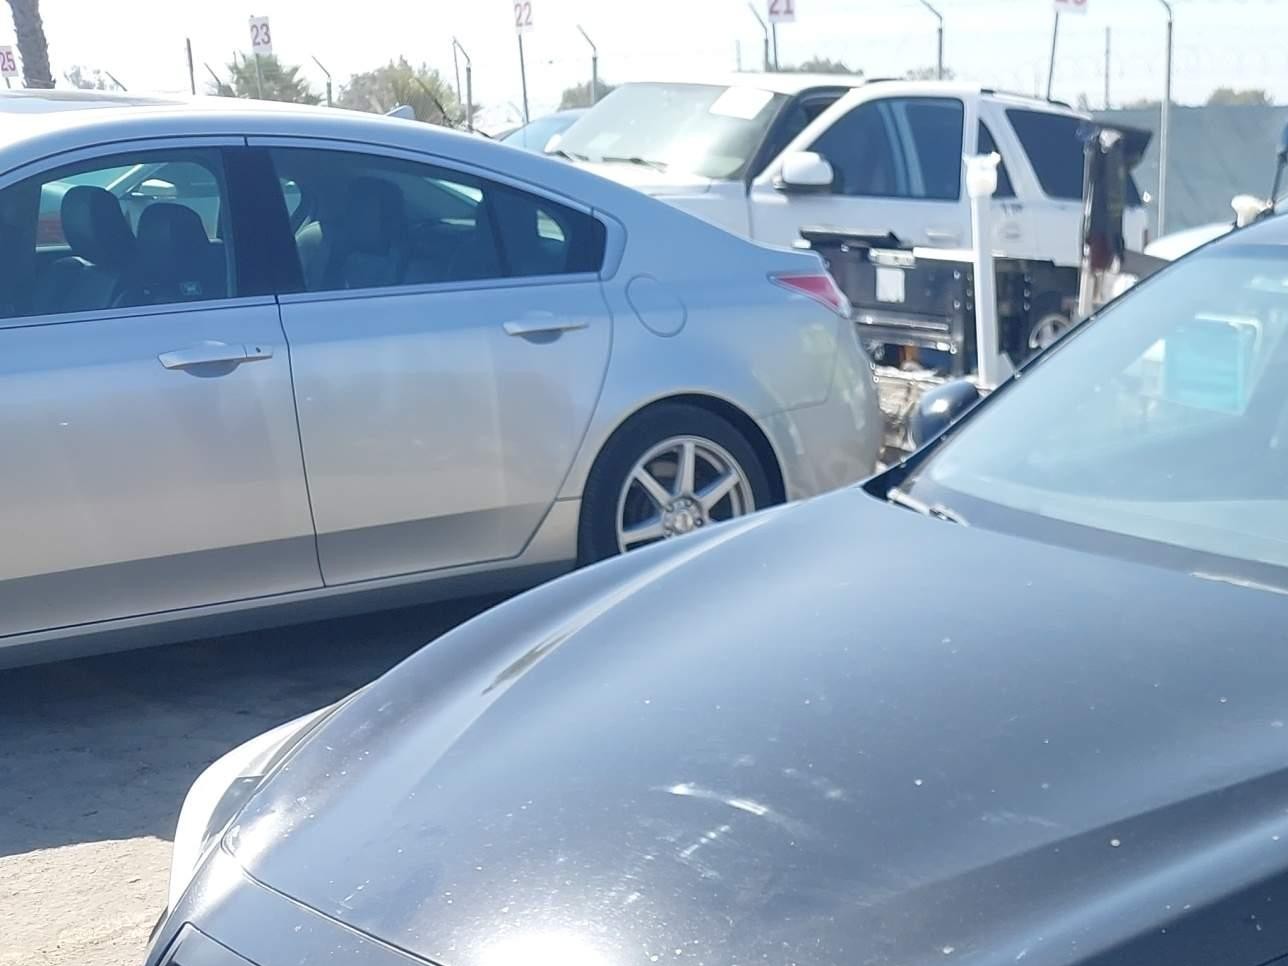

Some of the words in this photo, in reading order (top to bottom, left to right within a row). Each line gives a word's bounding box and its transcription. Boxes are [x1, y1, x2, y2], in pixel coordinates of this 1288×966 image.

[514, 1, 532, 27] 22
[250, 23, 271, 46] 23
[0, 51, 16, 71] 25
